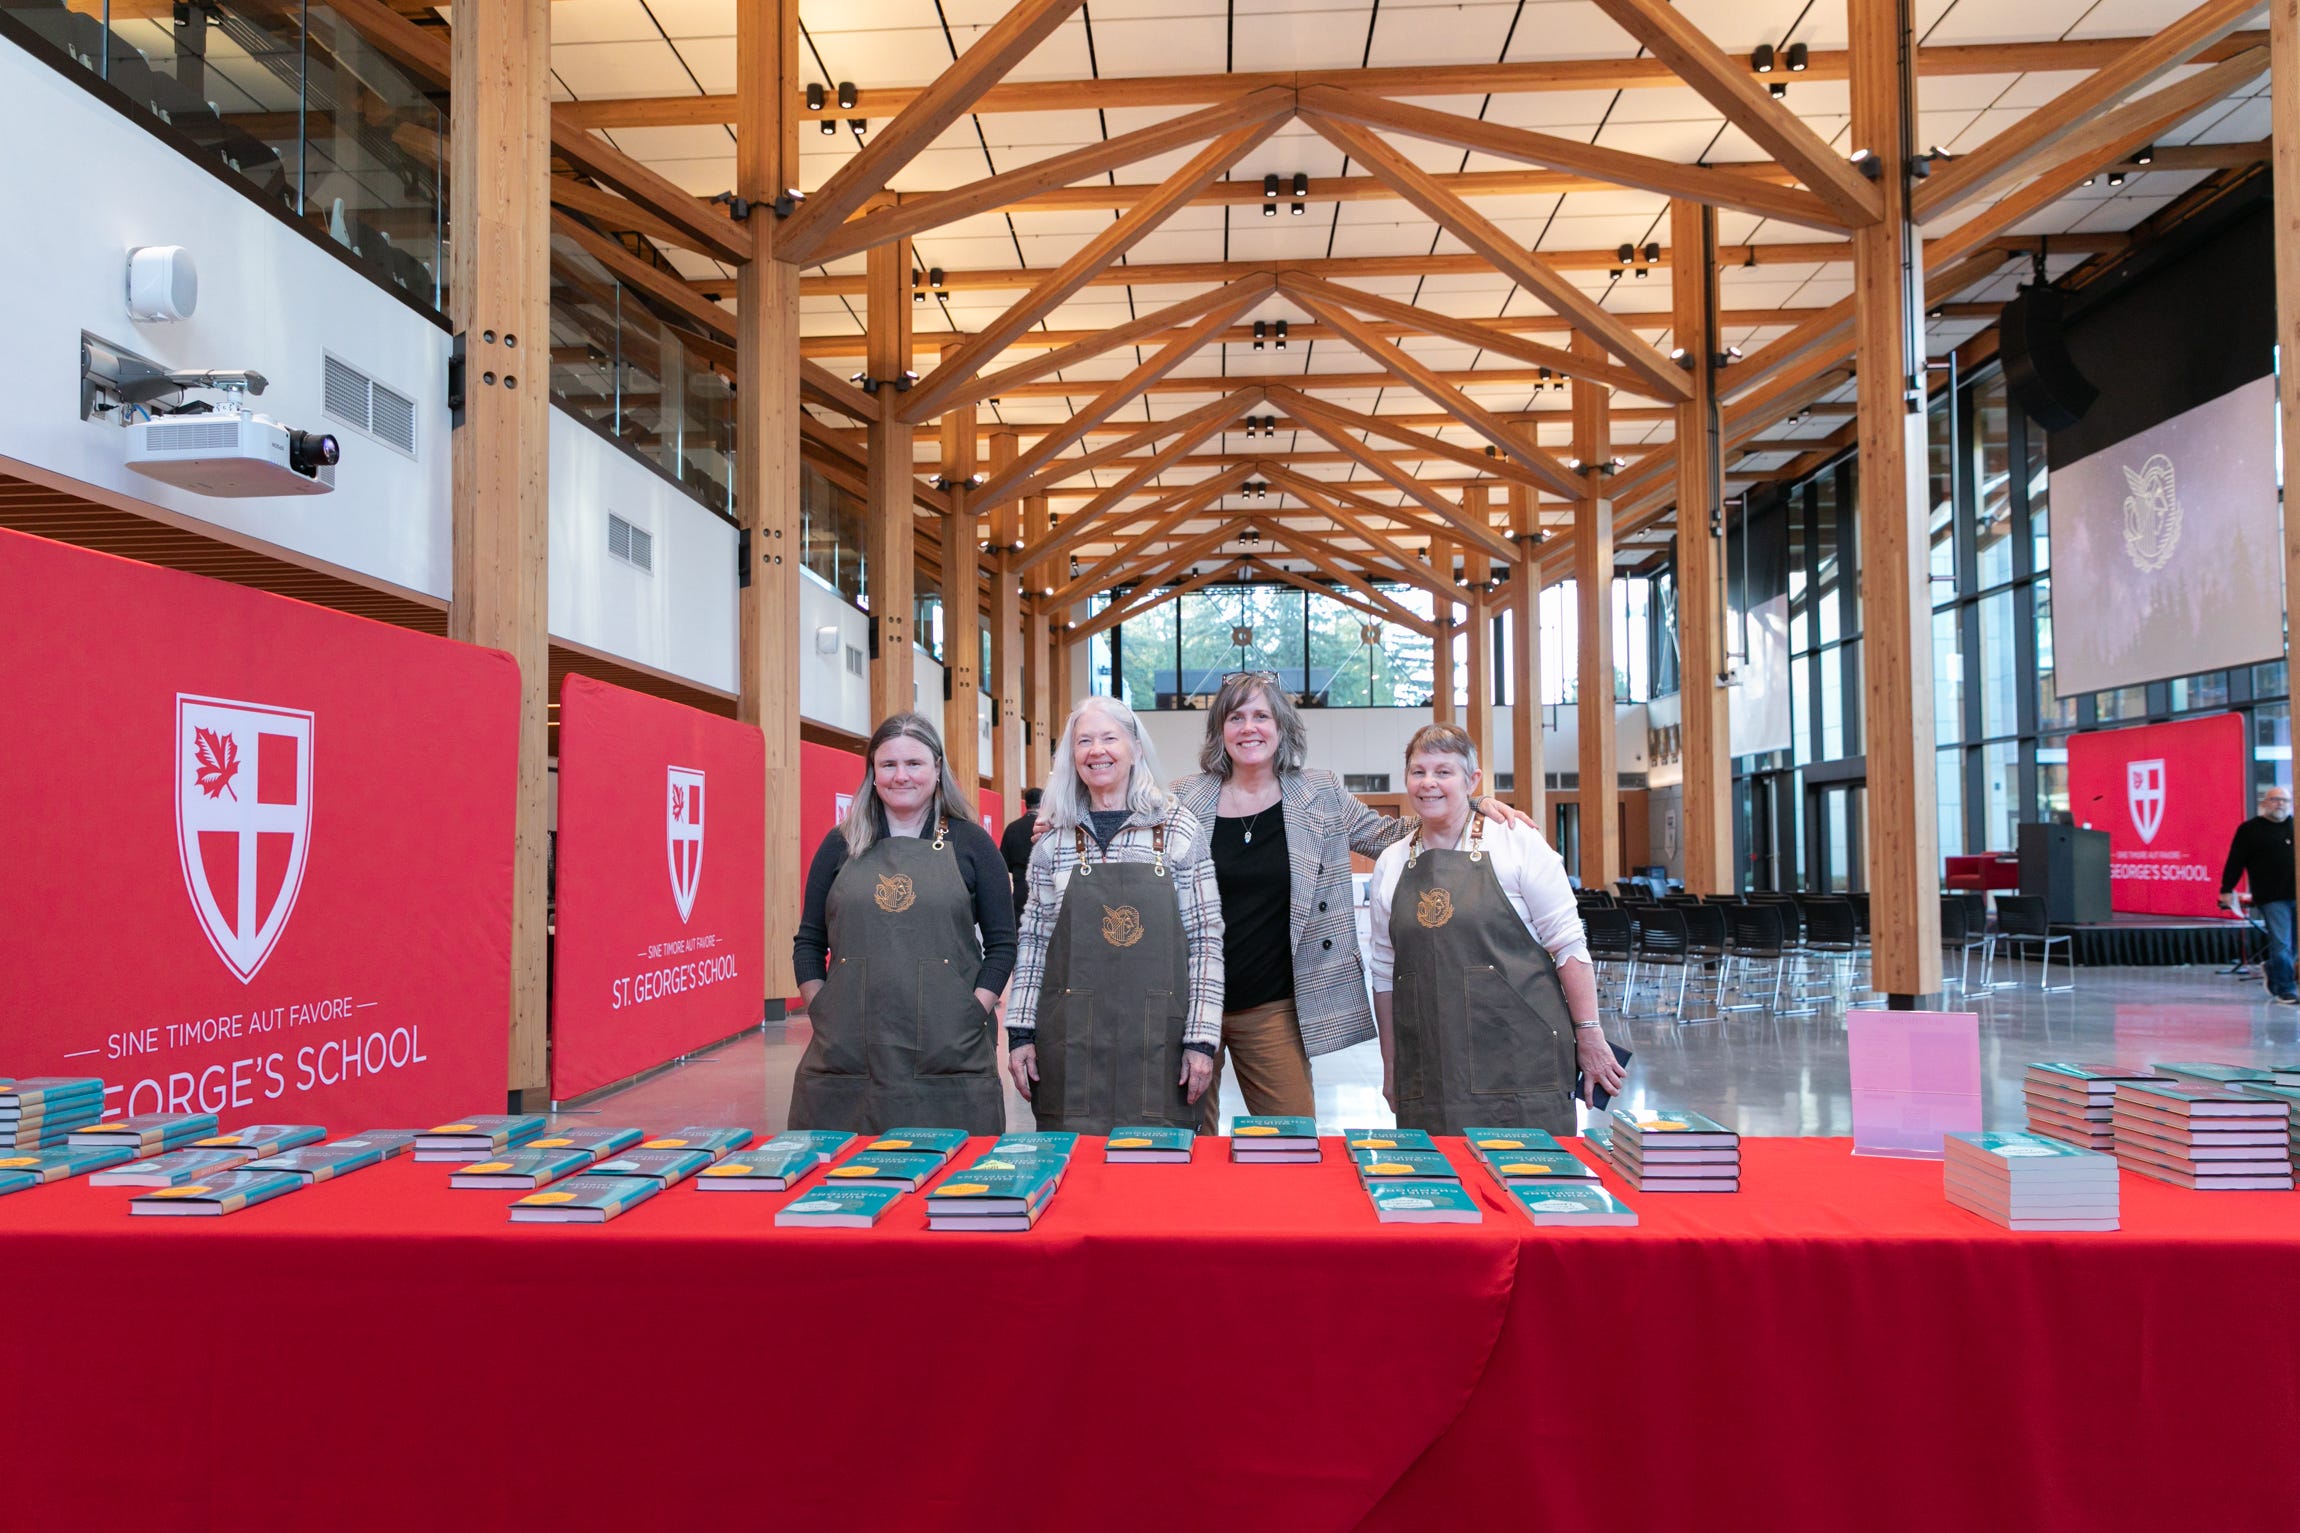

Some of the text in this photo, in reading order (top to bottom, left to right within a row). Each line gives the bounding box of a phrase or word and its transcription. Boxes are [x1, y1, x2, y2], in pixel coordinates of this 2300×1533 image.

[2161, 864, 2211, 882] SCHOOL
[648, 934, 716, 959] SINE TIMORE AUT FAVORE
[612, 954, 738, 1009] ST. GEORGE'S SCHOOL
[107, 996, 353, 1060] SINE TIMORE AUT FAVORE
[296, 1024, 427, 1091] SCHOOL
